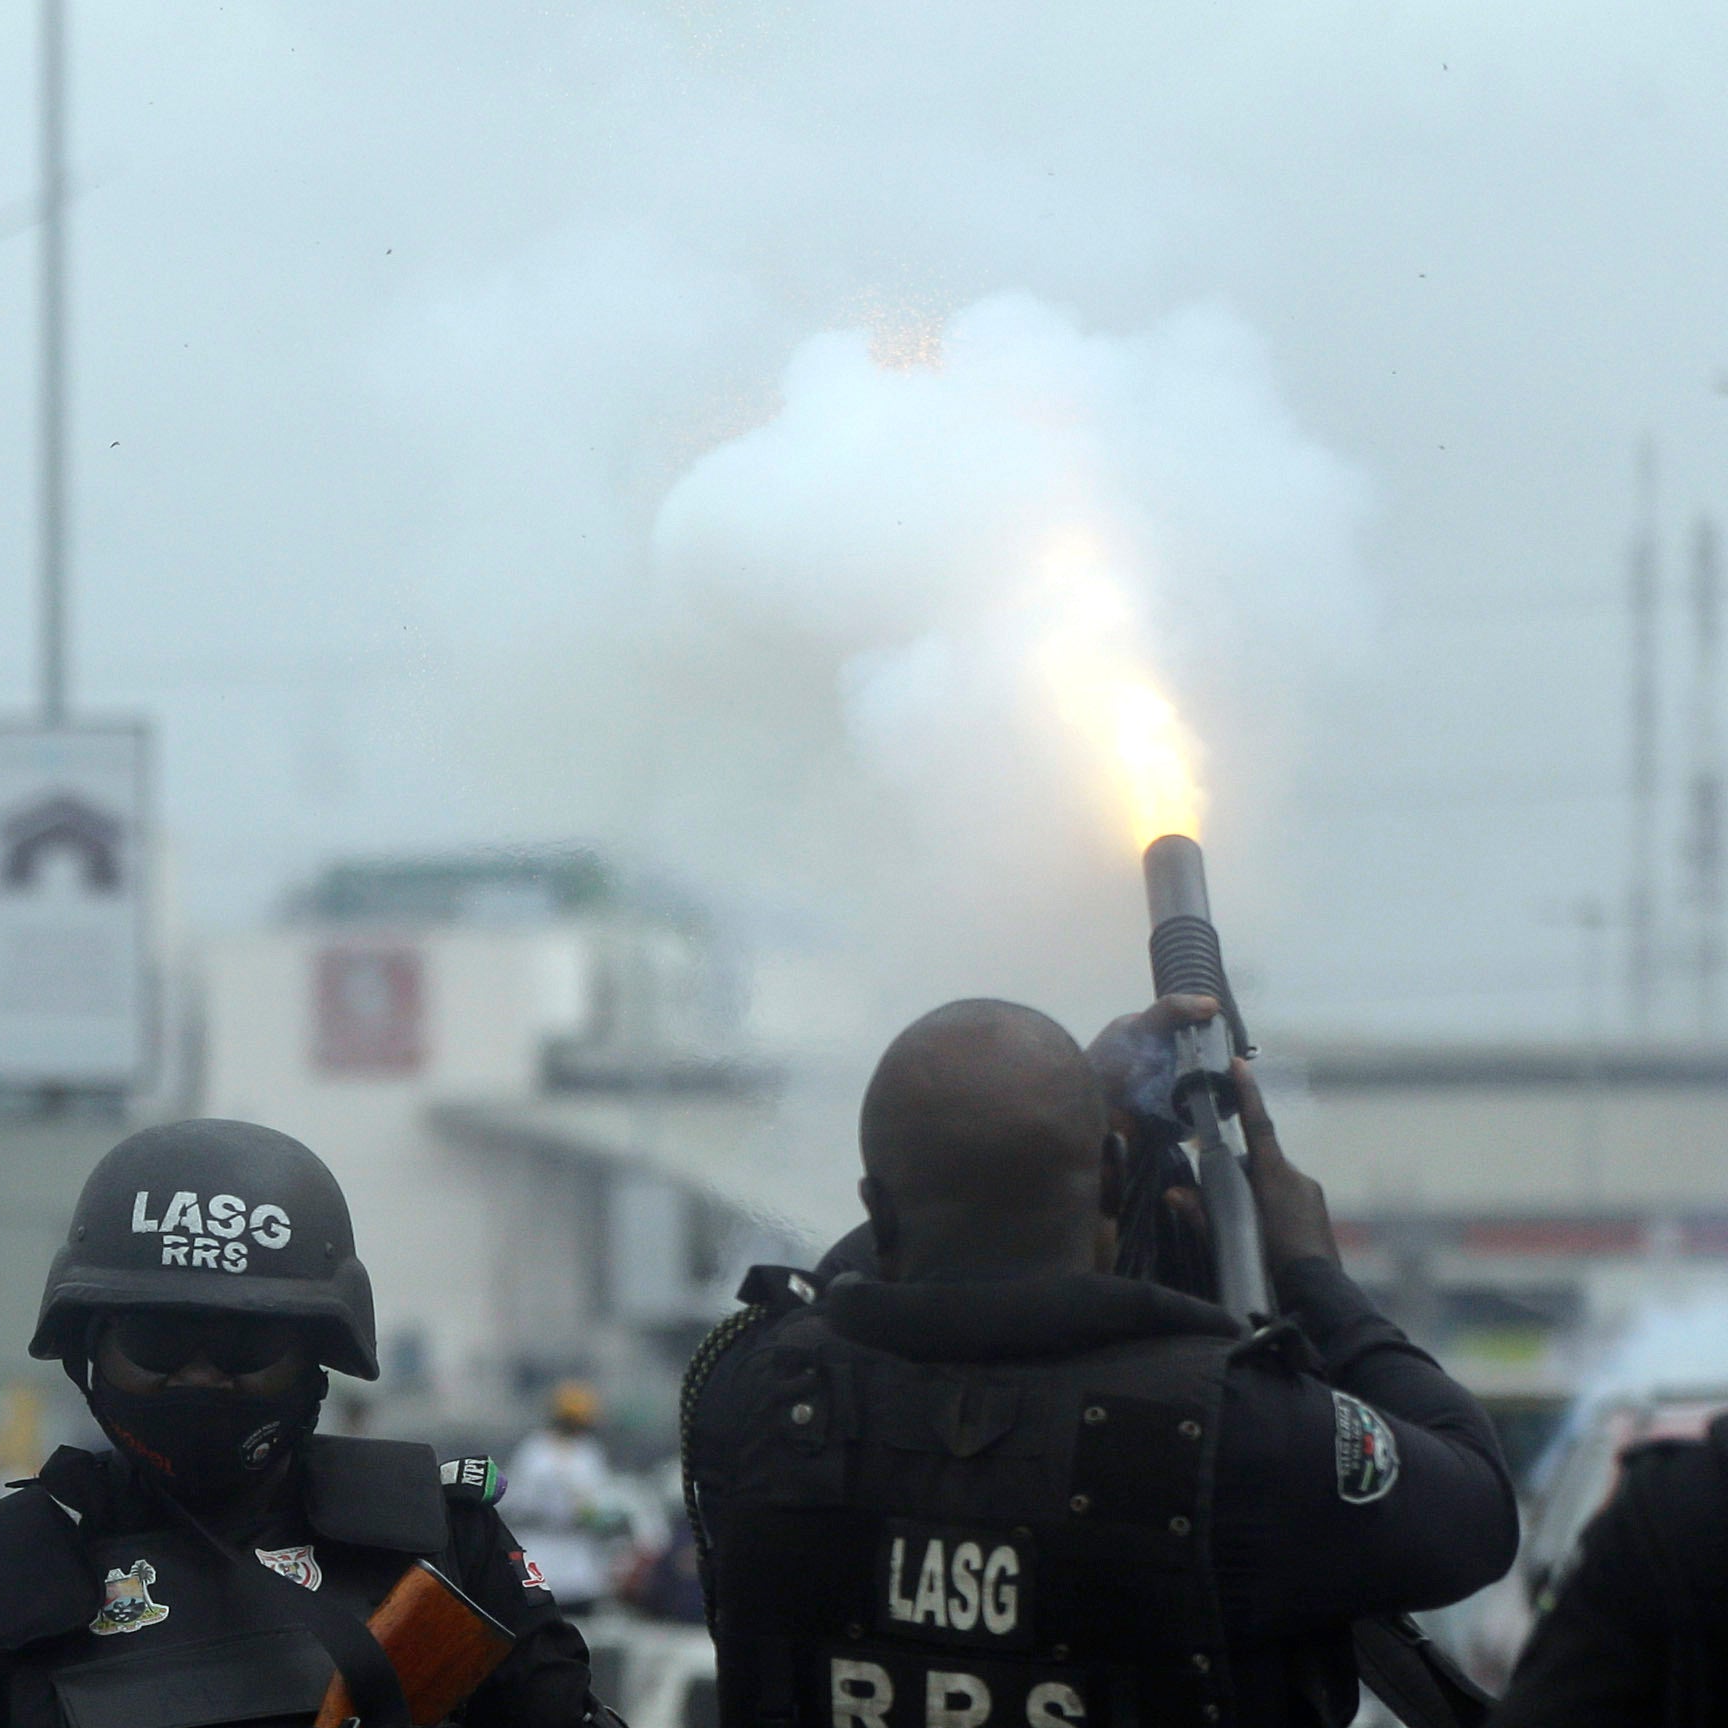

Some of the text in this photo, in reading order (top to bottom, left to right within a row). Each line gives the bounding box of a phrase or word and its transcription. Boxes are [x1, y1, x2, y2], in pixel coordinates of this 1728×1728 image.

[131, 1190, 292, 1250] LASG
[161, 1234, 248, 1274] RRS
[888, 1537, 1020, 1635] LASG
